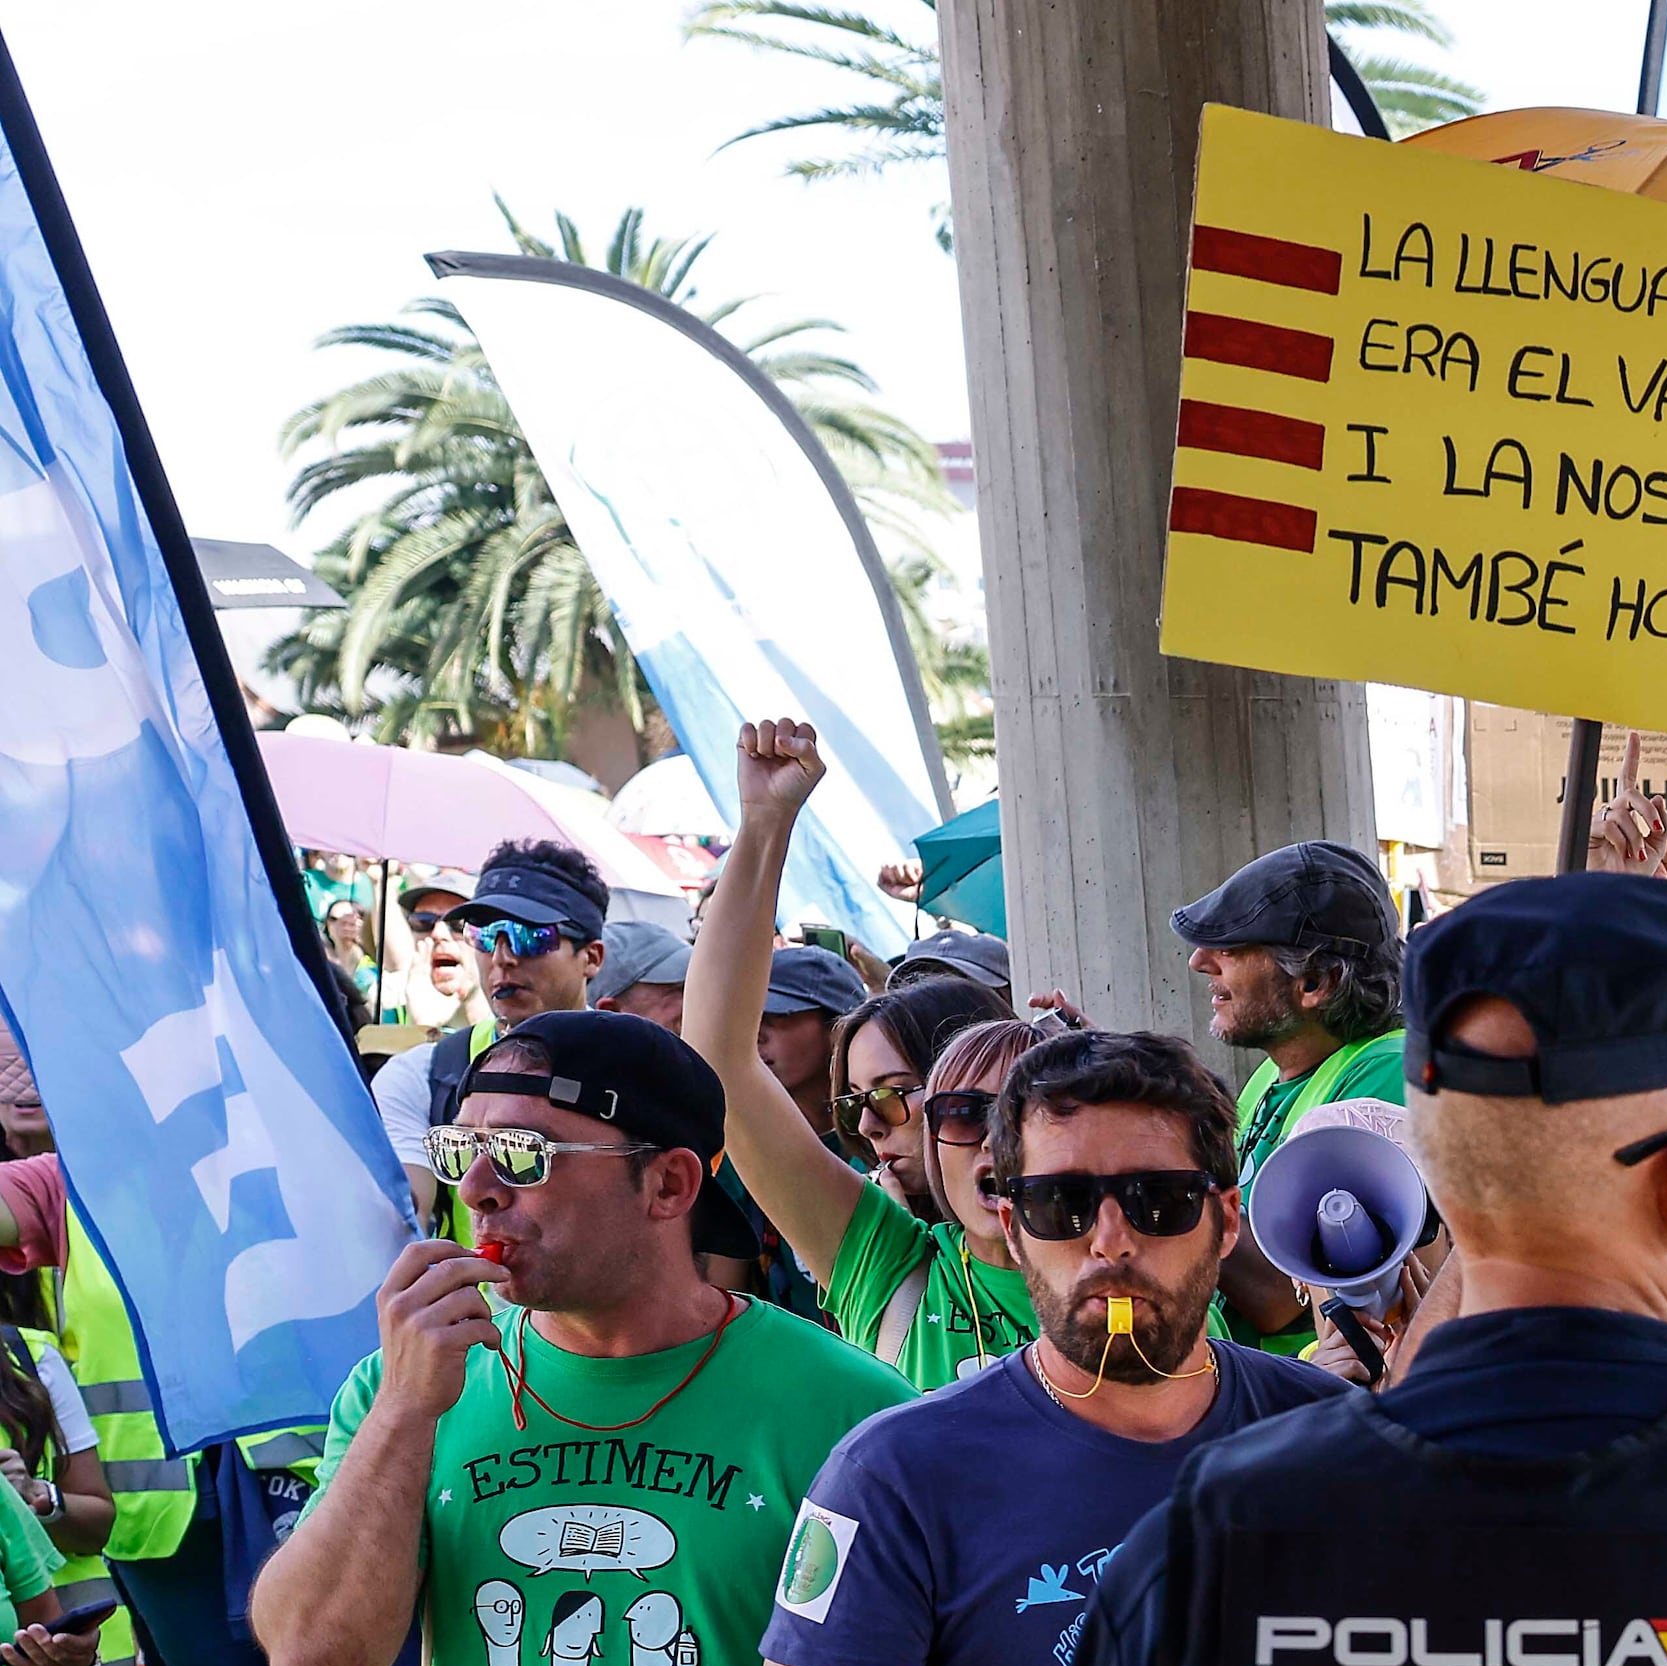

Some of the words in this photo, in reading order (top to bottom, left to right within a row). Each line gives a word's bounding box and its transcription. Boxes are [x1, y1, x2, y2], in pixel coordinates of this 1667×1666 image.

[1360, 214, 1433, 287] LA
[1360, 319, 1479, 392] ERA
[1508, 346, 1593, 407] EL
[1347, 424, 1391, 483] I
[1443, 436, 1532, 509] LA
[1328, 530, 1585, 634] TAMBÉ
[463, 1438, 743, 1510] ESTIMEM
